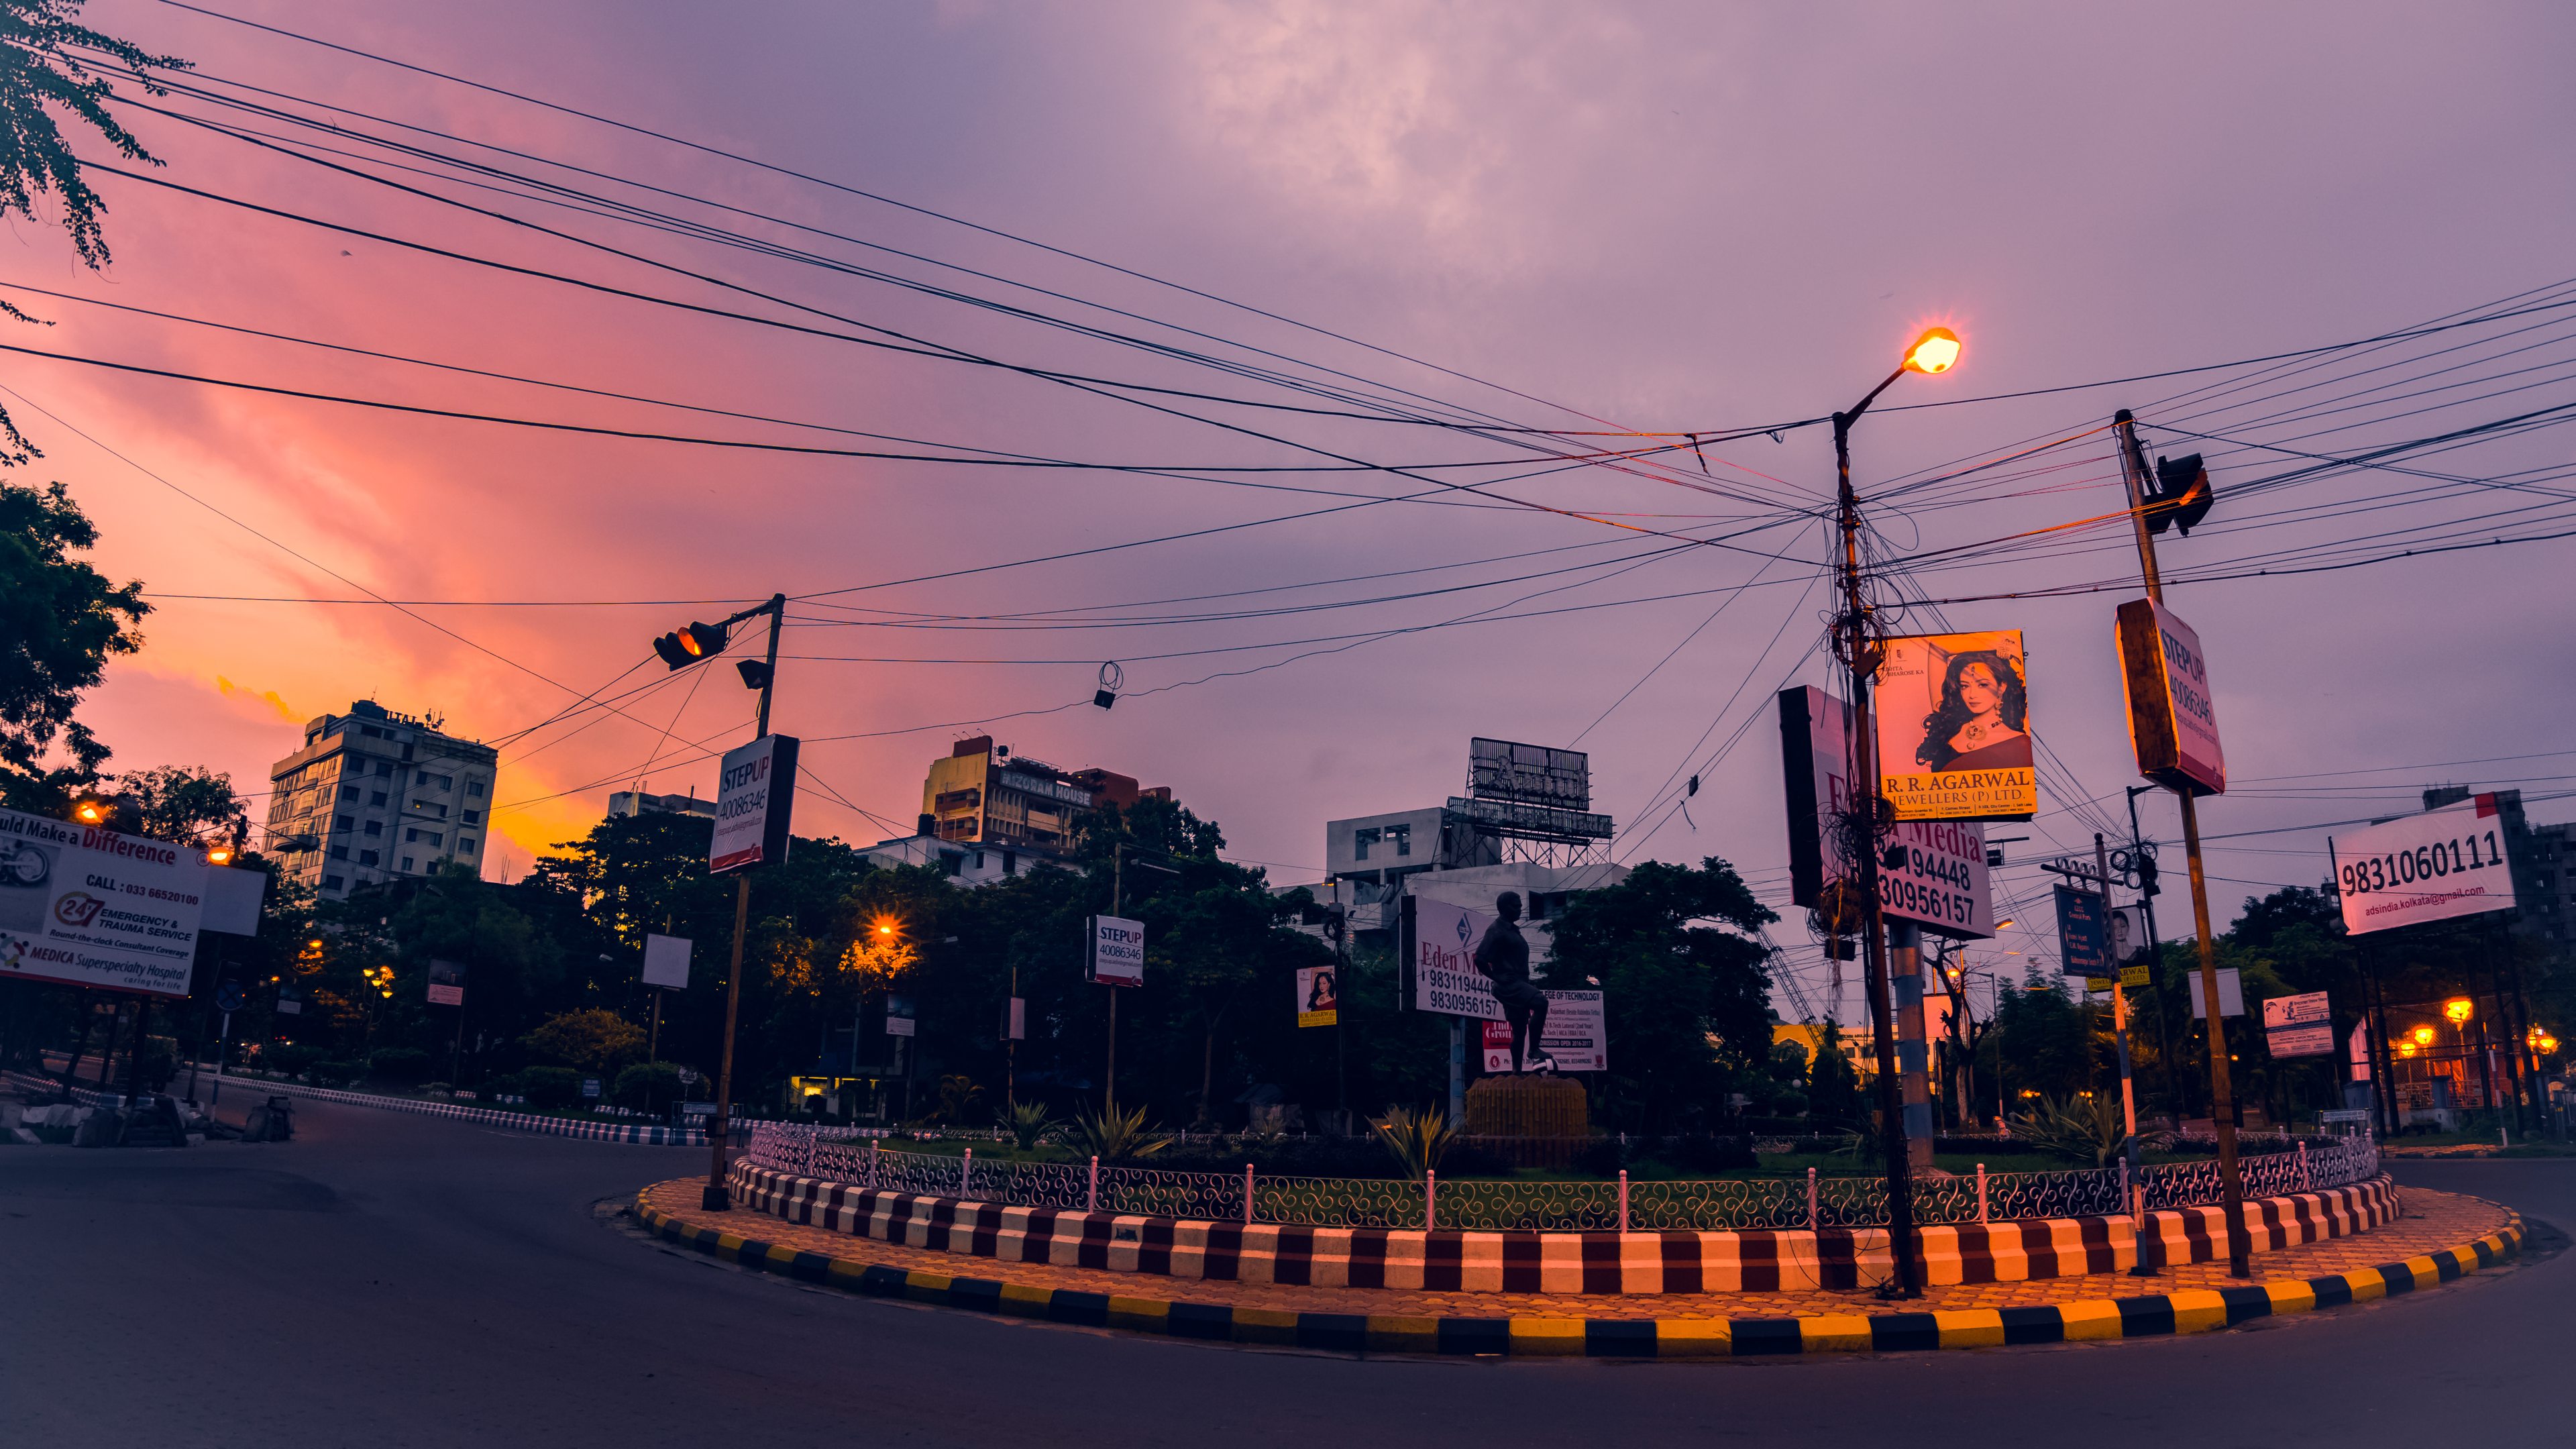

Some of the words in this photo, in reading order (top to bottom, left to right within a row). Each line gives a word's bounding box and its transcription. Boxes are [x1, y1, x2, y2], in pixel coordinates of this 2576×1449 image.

[2161, 628, 2204, 685] STEPUP
[2169, 674, 2212, 726] 40086346
[722, 755, 770, 793] STEPUP
[1002, 772, 1053, 796] MIZORAM
[1056, 785, 1091, 806] HOUSE
[1886, 778, 1903, 793] R.
[1907, 777, 1925, 792] R.
[1929, 771, 2030, 791] AGARWAL
[719, 788, 766, 821] 40086346
[1893, 792, 1968, 806] JEWELLERS
[1972, 791, 1990, 803] (P)
[1995, 789, 2026, 801] LTD.
[25, 819, 67, 843] Make
[69, 832, 78, 845] a
[82, 827, 176, 865] Difference
[1908, 821, 1982, 863] Media
[2343, 830, 2503, 897] 9831060111
[86, 873, 117, 892] CALL
[126, 884, 145, 897] 033
[148, 888, 199, 906] 66520100
[2365, 885, 2485, 917] adsindia.kolkata@gmail.com
[99, 918, 144, 934] TRAUMA
[147, 927, 193, 942] SERVICE
[100, 908, 170, 927] EMERGENCY
[171, 920, 178, 929] &
[49, 928, 113, 947] Round-the-clock
[114, 939, 155, 953] Consultant
[156, 946, 190, 958] Coverage
[1101, 926, 1142, 944] STEPUP
[30, 947, 74, 965] MEDICA
[75, 953, 146, 975] Superspecialty
[147, 964, 187, 981] Hospital
[1099, 944, 1142, 960] 40086346
[1421, 941, 1458, 972] Eden
[124, 977, 152, 987] caring
[153, 979, 166, 988] for
[166, 981, 182, 991] life
[1557, 991, 1565, 1000] OF
[1565, 991, 1600, 1002] TECHNOLOGY
[1430, 990, 1498, 1016] 9830956157
